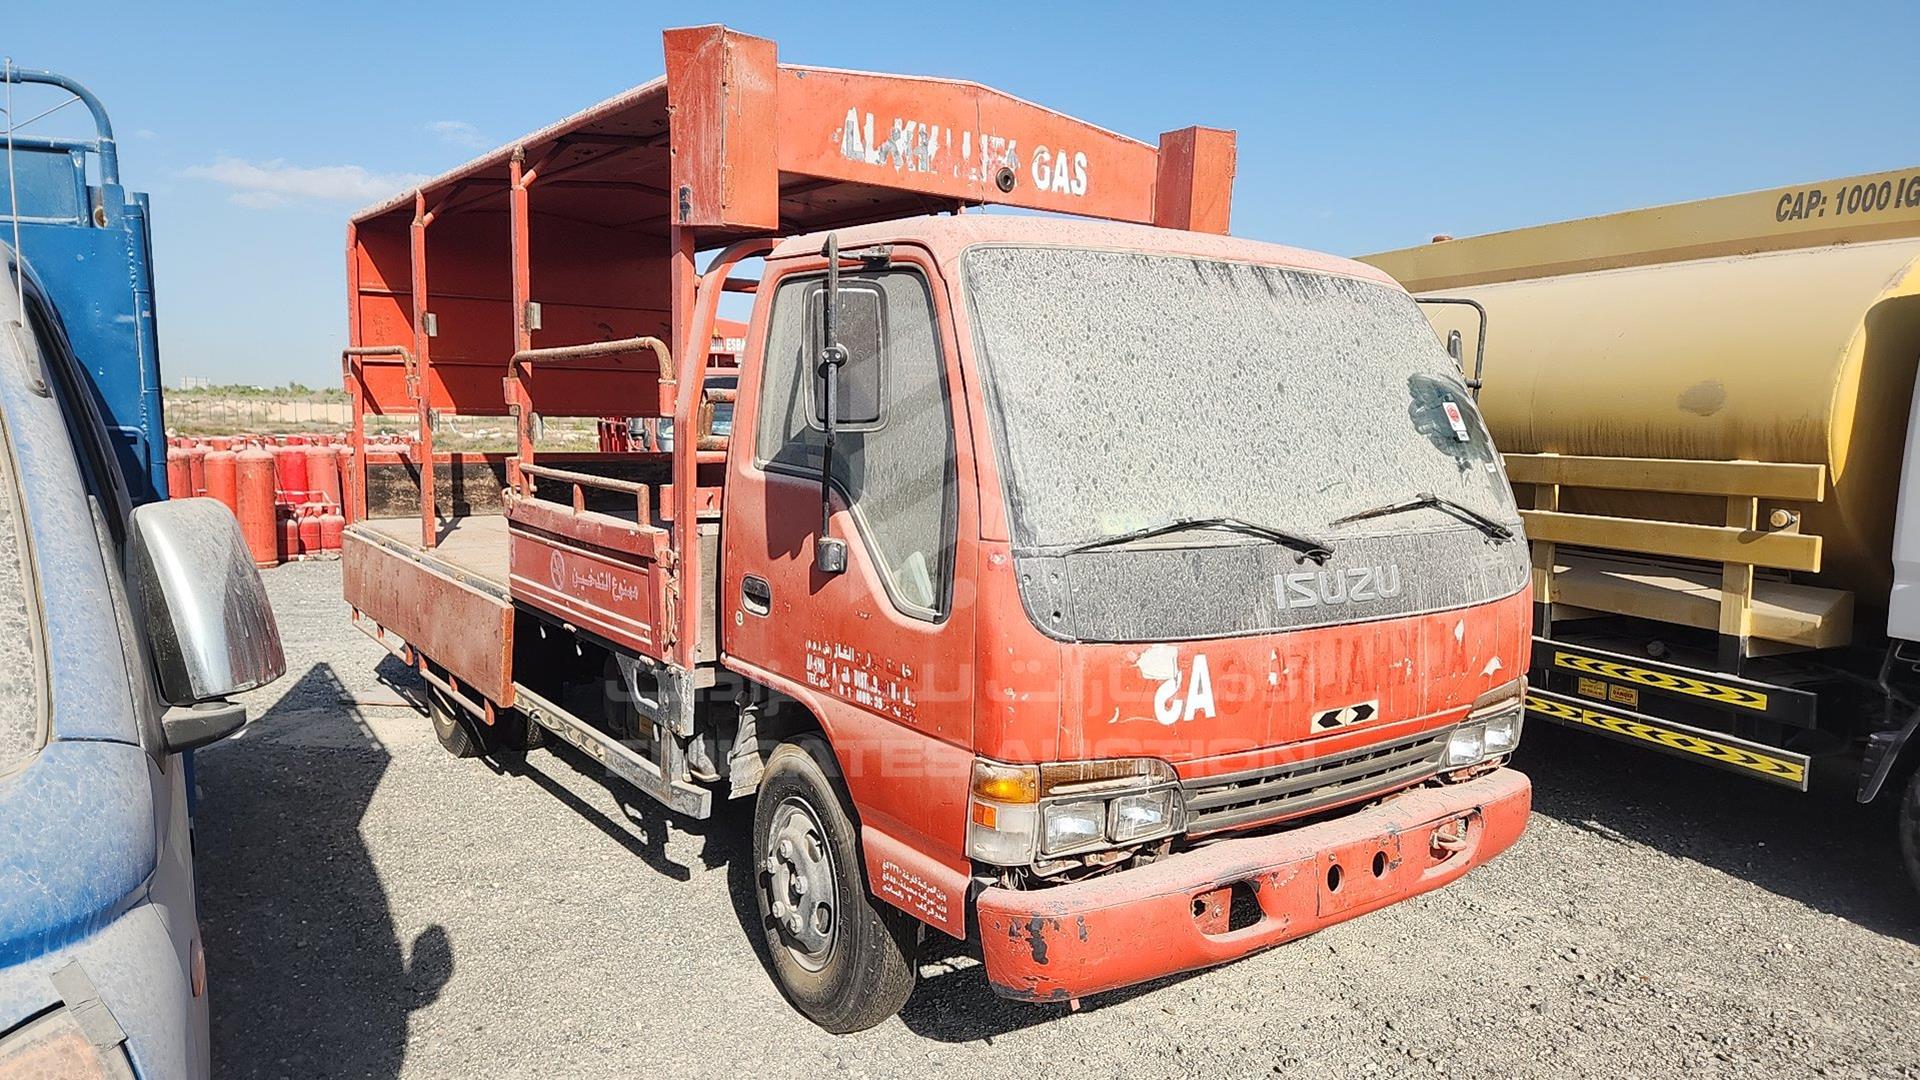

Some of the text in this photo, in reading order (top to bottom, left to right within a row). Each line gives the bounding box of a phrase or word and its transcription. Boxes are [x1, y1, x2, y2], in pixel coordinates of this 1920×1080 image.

[1031, 145, 1088, 197] GAS
[1775, 190, 1827, 222] CAP:
[1836, 181, 1892, 216] 1000
[1273, 564, 1401, 609] ISUZU
